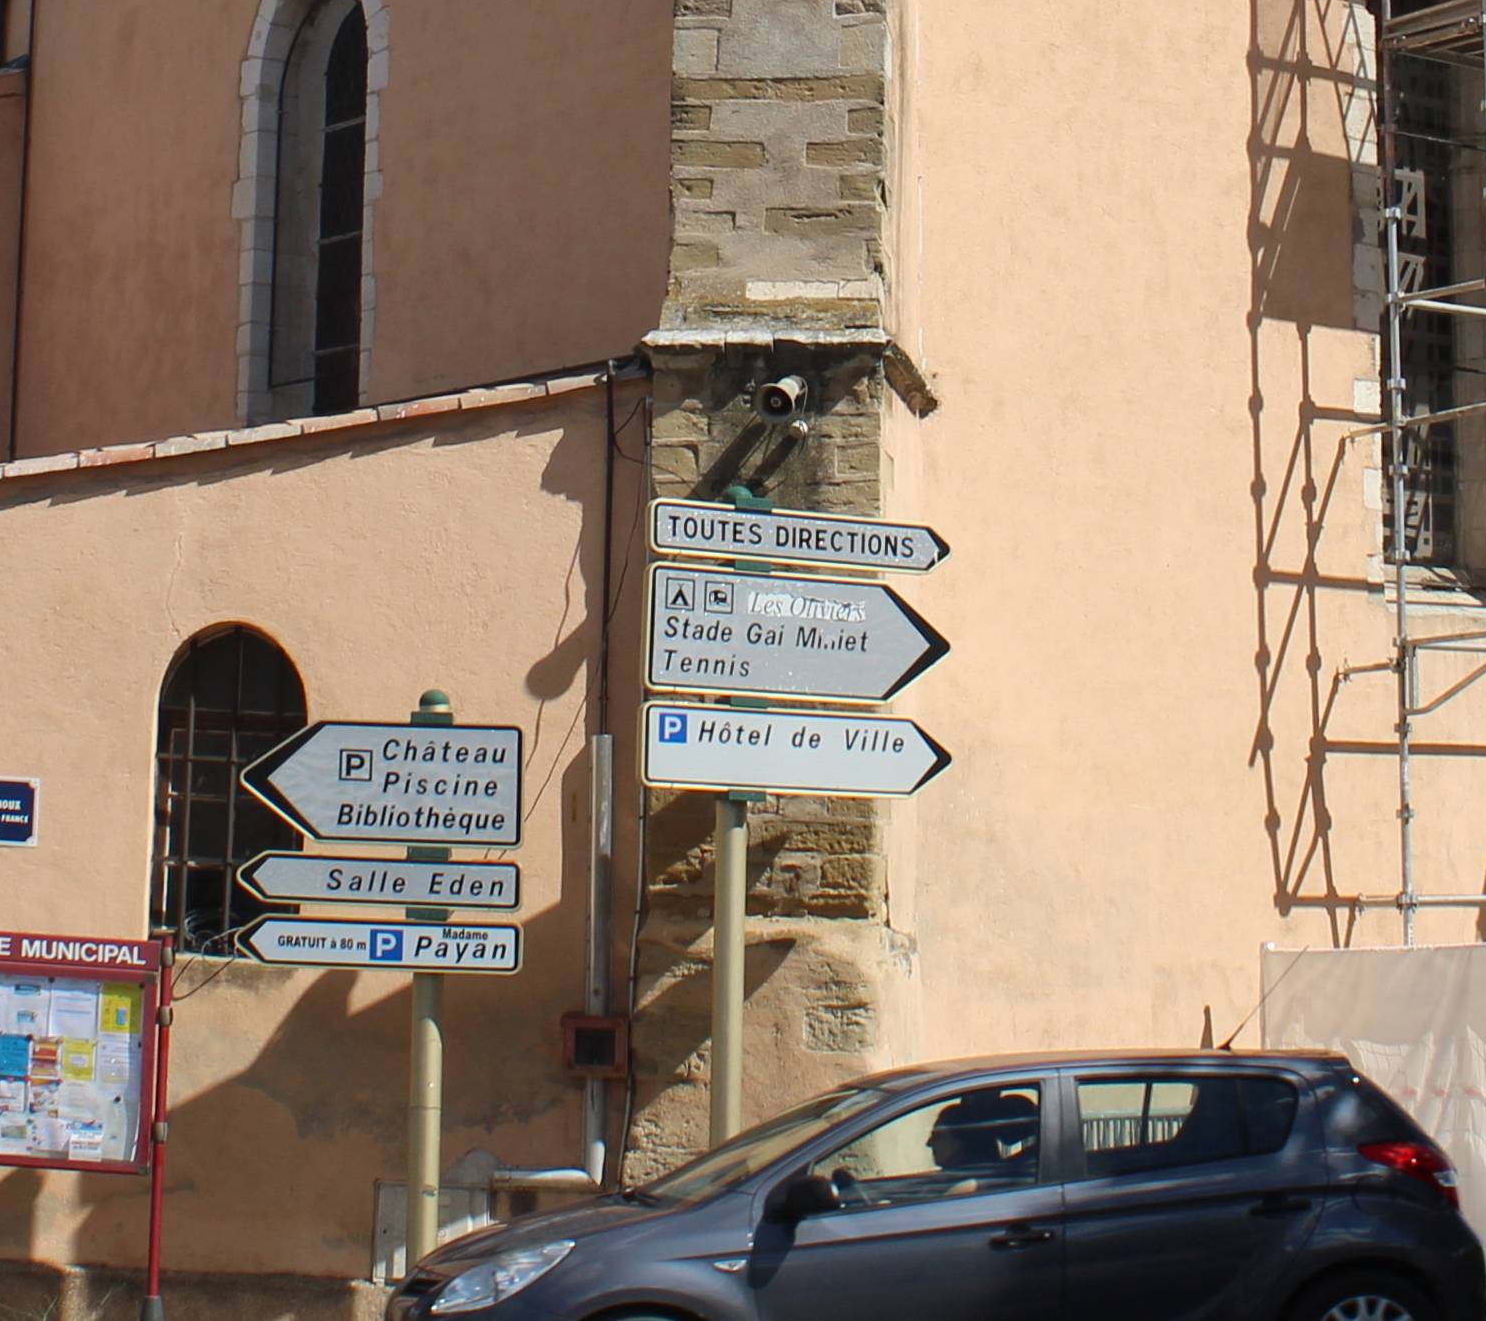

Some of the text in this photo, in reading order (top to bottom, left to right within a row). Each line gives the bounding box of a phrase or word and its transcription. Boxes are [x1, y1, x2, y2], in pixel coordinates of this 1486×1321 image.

[668, 515, 915, 558] TOUTES DIRECTIONS
[751, 593, 782, 615] Les
[664, 616, 733, 643] Stade
[747, 622, 785, 647] Gai
[663, 649, 751, 678] Tennis
[382, 739, 507, 764] Château
[698, 720, 772, 747] Hôtel
[792, 726, 822, 749] de
[844, 728, 906, 754] Ville
[382, 772, 499, 797] Piscine
[327, 868, 504, 897] Salle Eden
[277, 934, 327, 949] GRATUIT
[330, 936, 337, 949] à
[340, 938, 354, 950] 80
[356, 940, 367, 951] m
[414, 936, 508, 964] Payan
[442, 928, 489, 941] Madame
[20, 938, 147, 965] MUNICIPAL
